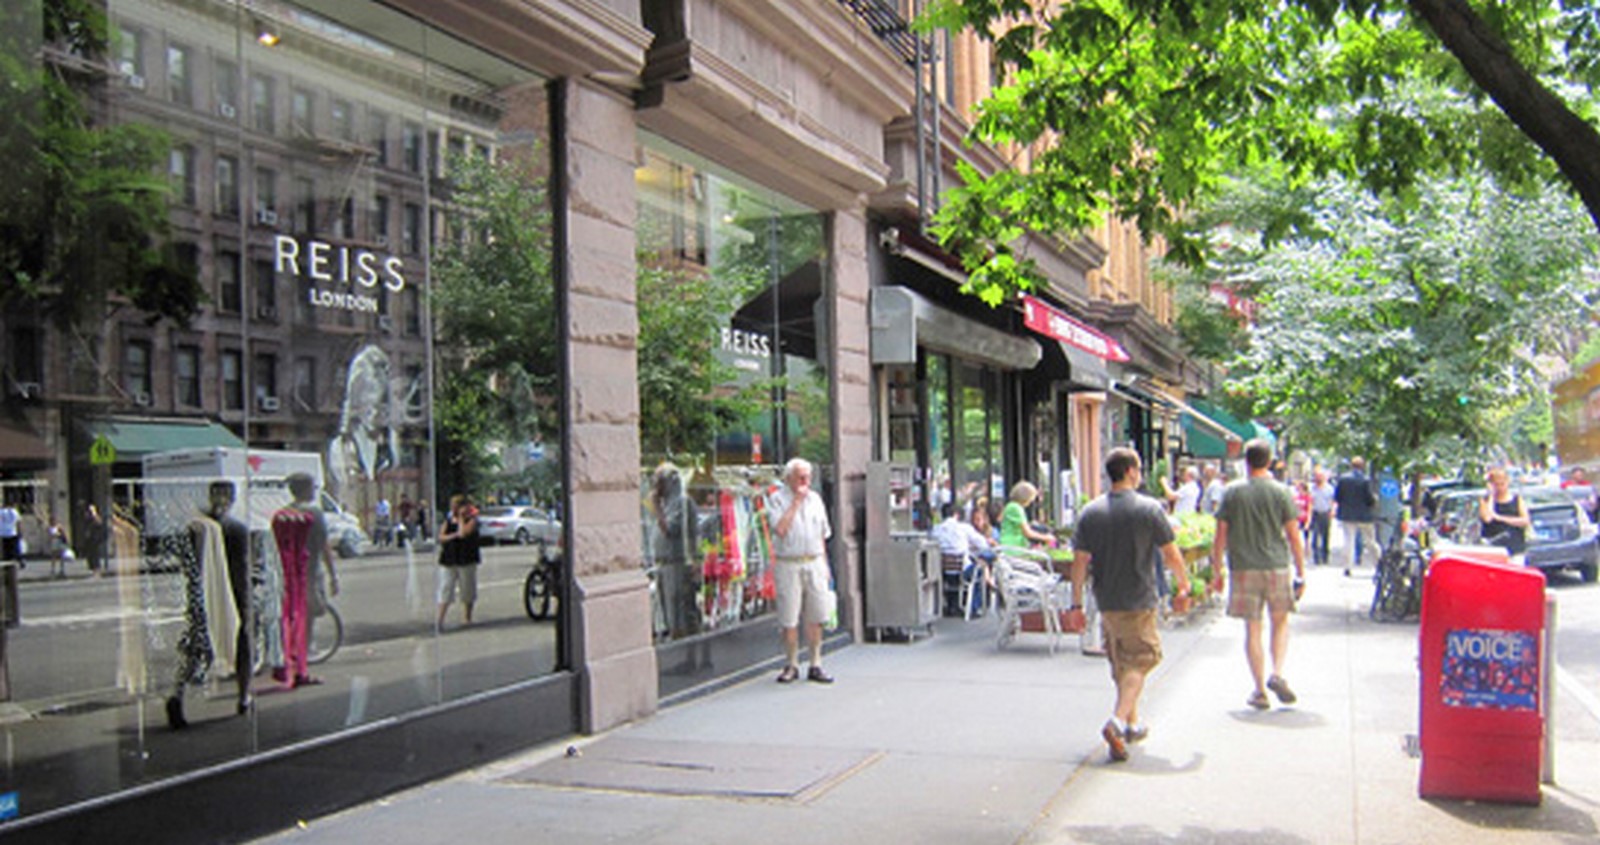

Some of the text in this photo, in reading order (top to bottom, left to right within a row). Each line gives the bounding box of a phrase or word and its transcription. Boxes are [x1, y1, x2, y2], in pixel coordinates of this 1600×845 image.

[275, 234, 405, 292] REISS
[310, 288, 378, 313] LONDON
[720, 326, 770, 358] REISS
[1452, 636, 1522, 660] VOICE
